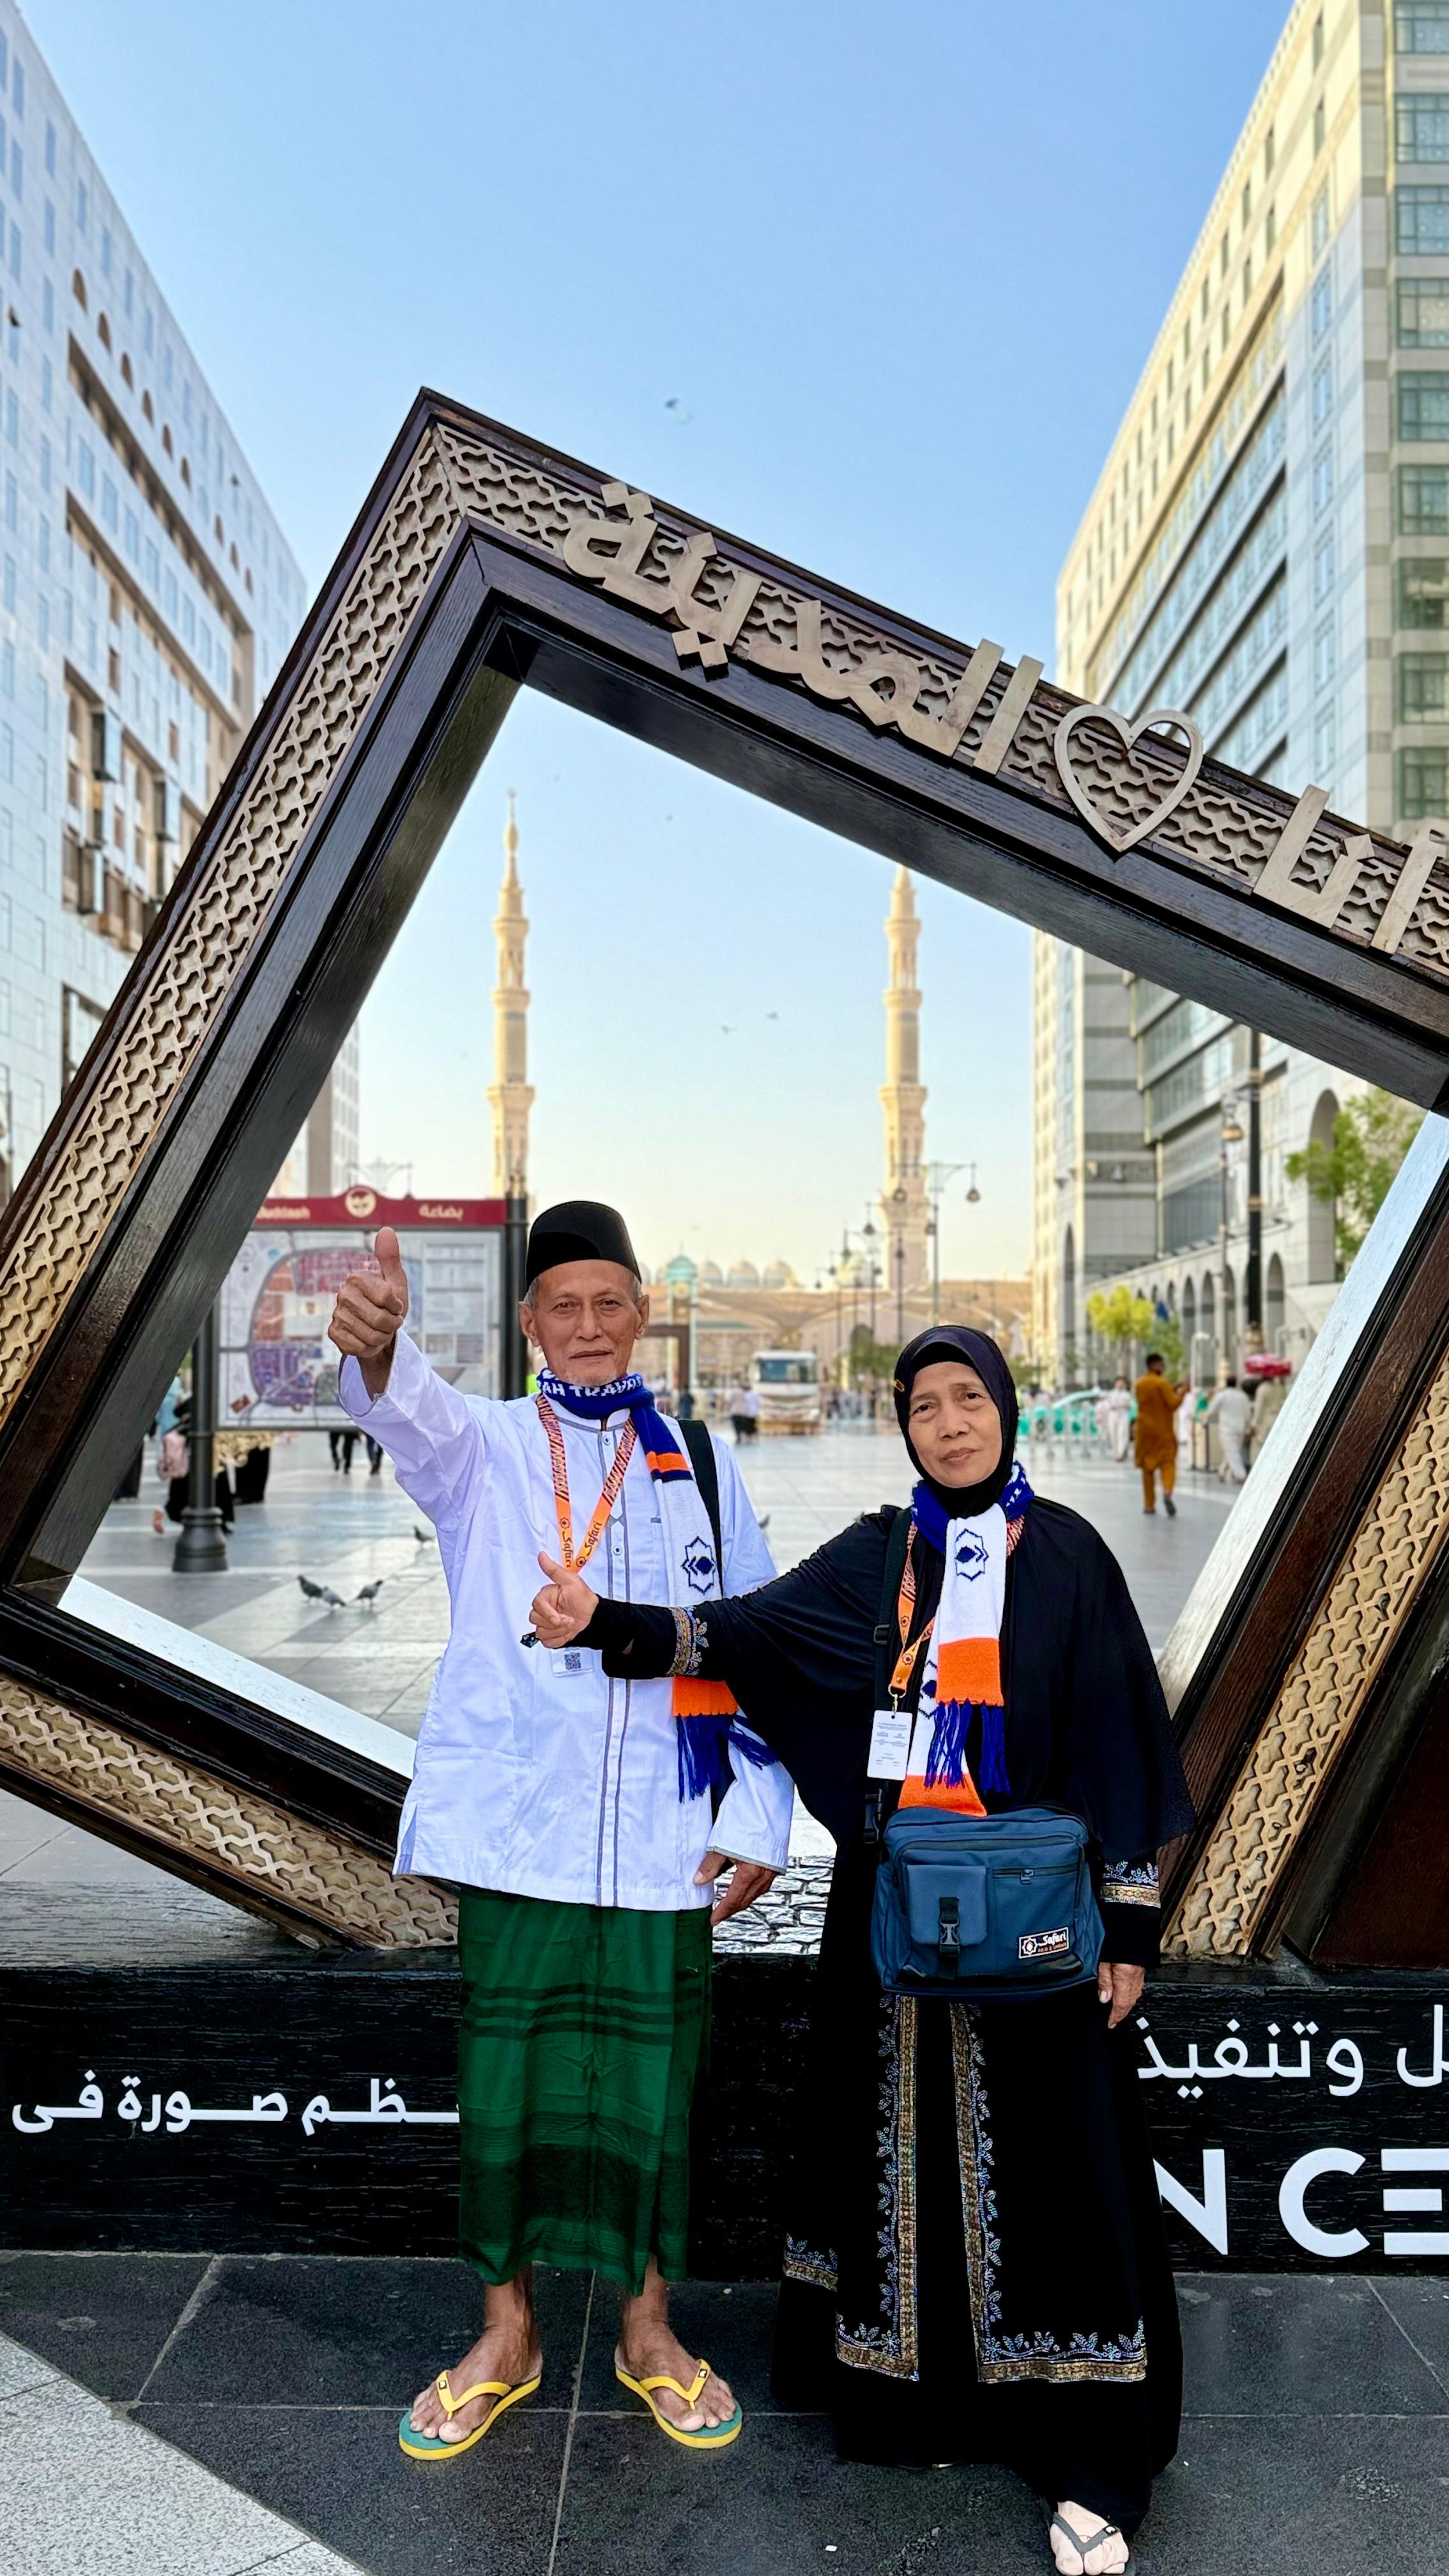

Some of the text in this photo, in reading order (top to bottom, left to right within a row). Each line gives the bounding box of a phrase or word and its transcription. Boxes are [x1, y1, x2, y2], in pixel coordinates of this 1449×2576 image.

[564, 481, 1045, 777] المدينة
[562, 1531, 574, 1567] Safari
[585, 1521, 602, 1556] Safari
[1038, 1931, 1066, 1946] Safari
